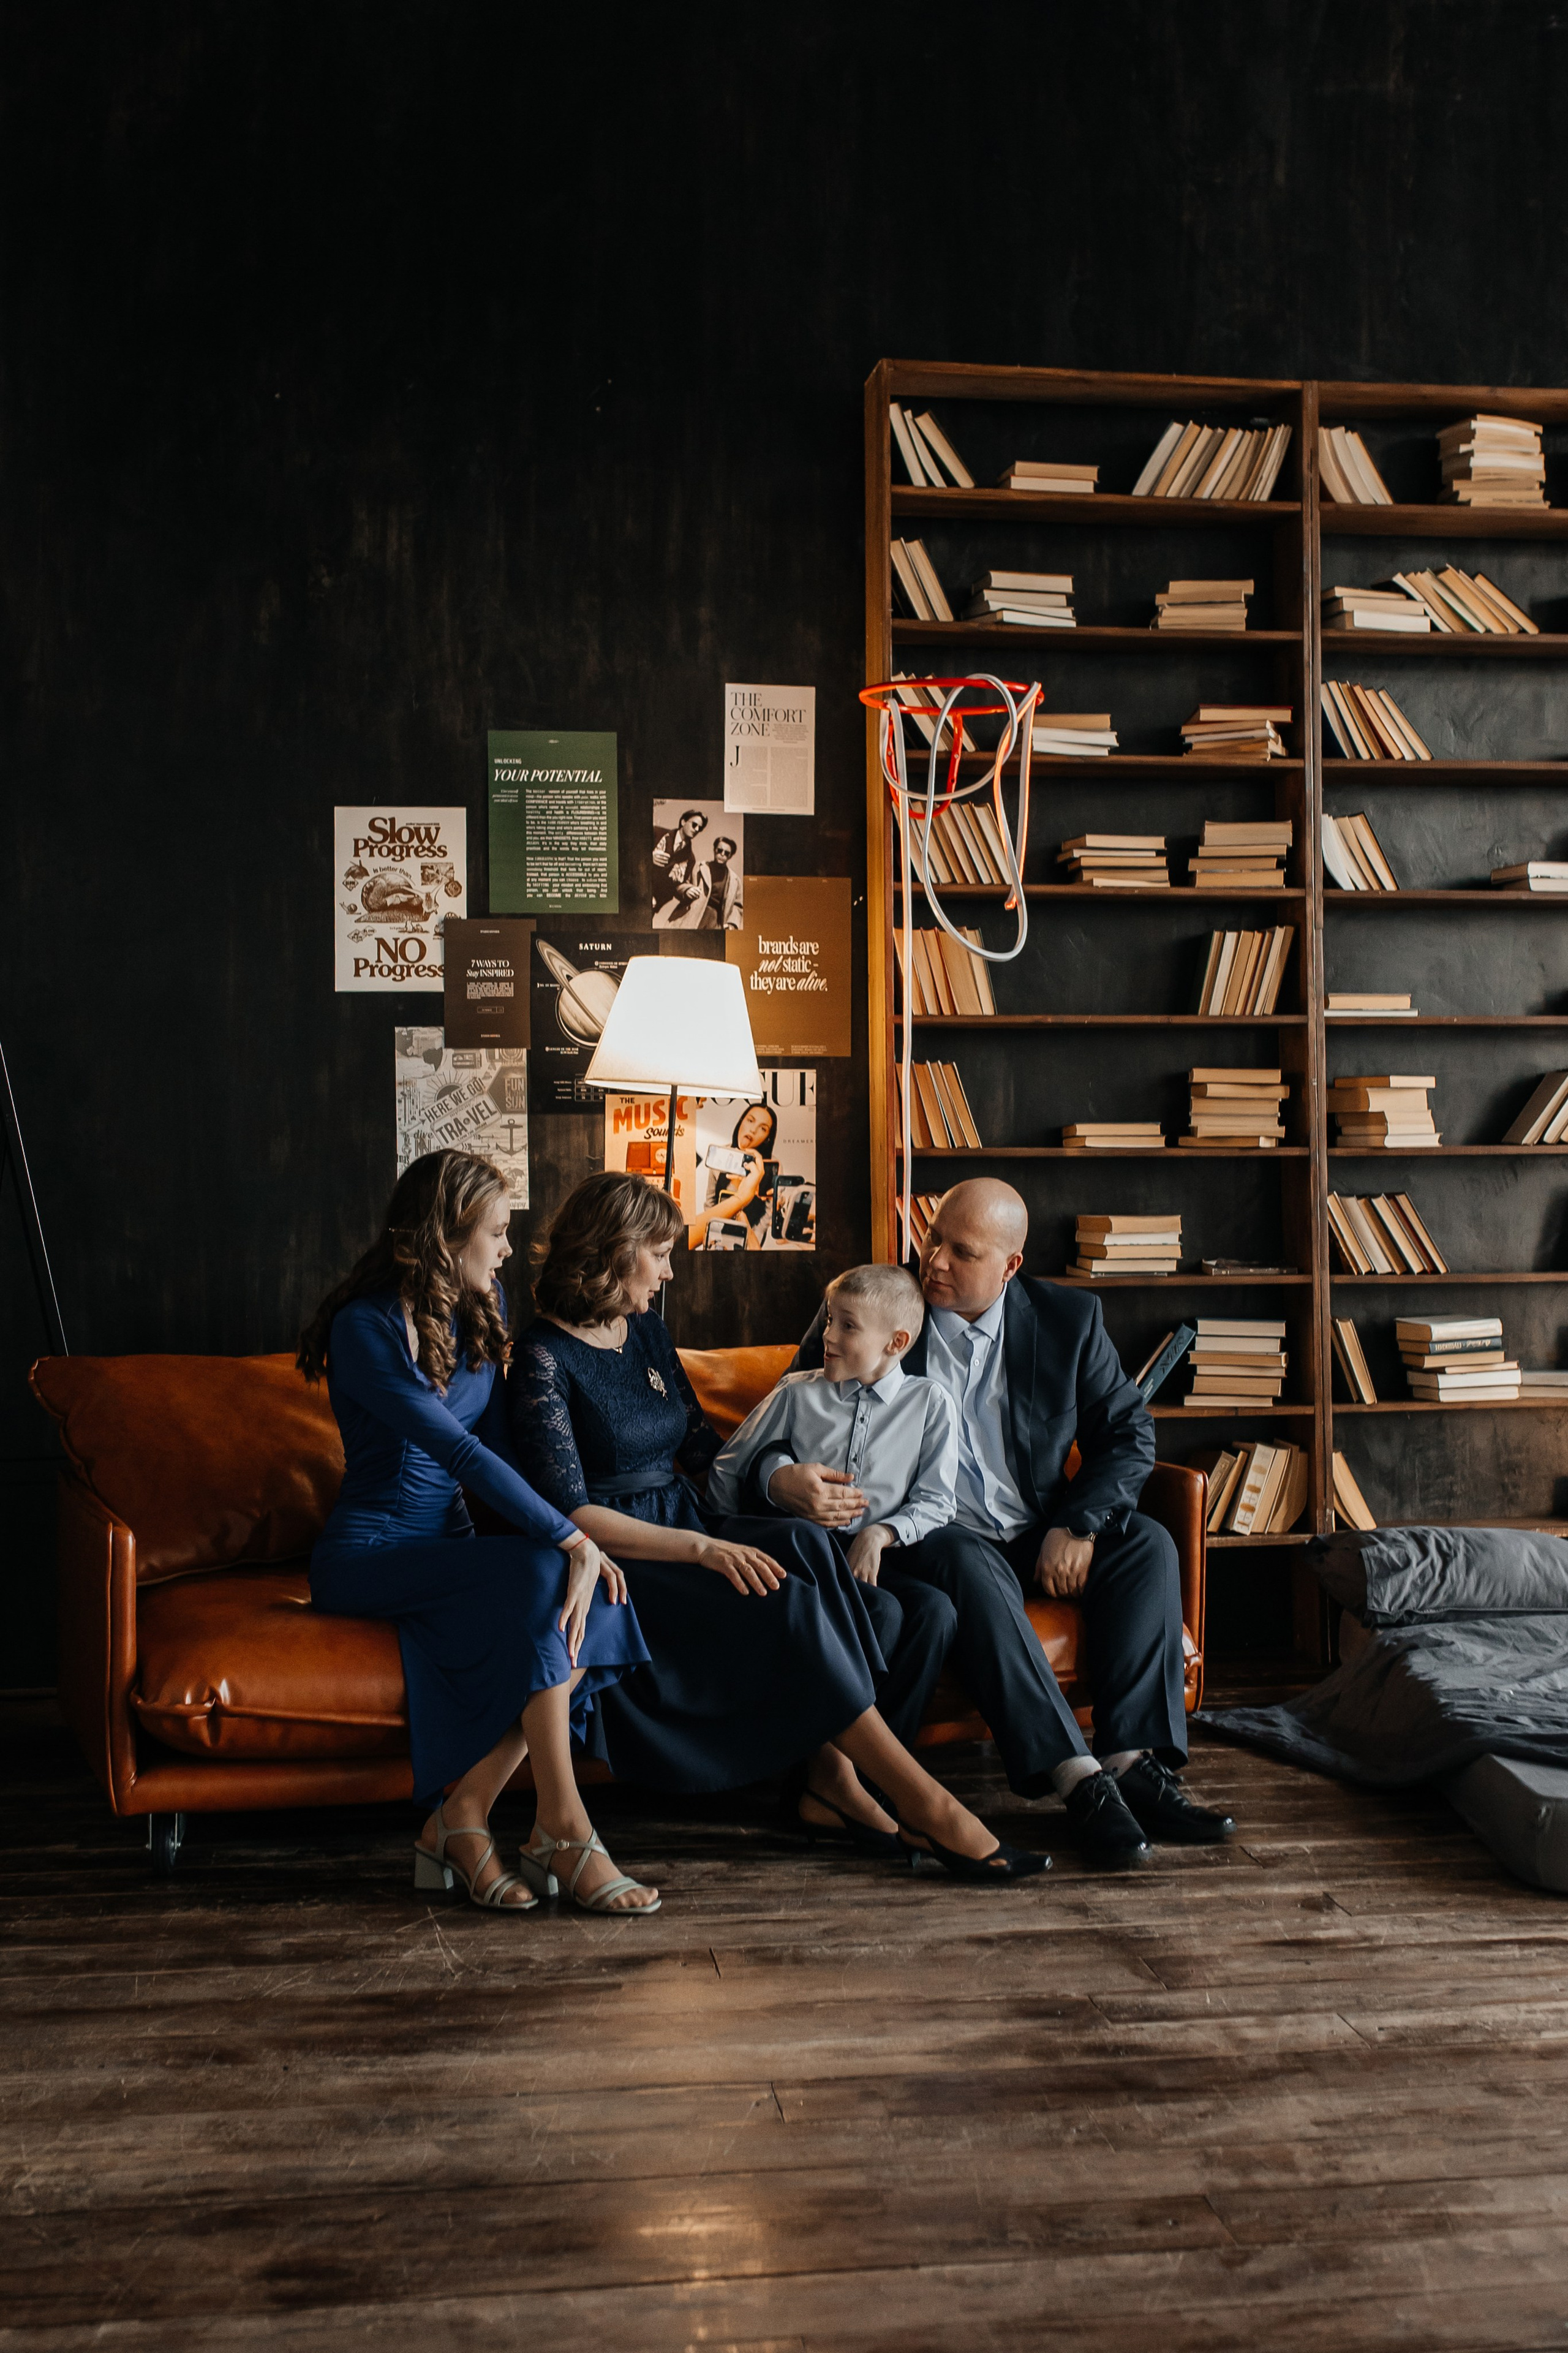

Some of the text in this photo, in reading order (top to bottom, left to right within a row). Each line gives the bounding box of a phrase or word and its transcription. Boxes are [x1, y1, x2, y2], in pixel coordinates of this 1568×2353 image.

[731, 692, 762, 707] THE
[730, 707, 806, 723] COMFORT
[731, 722, 770, 736] ZONE
[494, 769, 603, 783] YOUR POTENTIAL
[368, 817, 440, 845] Slow
[353, 837, 448, 862] Progress
[399, 868, 412, 880] than
[374, 937, 427, 964] NO
[758, 935, 820, 956] brands are
[353, 957, 444, 982] Progress
[471, 959, 510, 968] 7 WAYS TO
[758, 955, 783, 973] not
[782, 955, 812, 973] static
[466, 969, 514, 979] Stay INSPIRED
[750, 970, 828, 995] they are alive.
[505, 1078, 525, 1092] FUN
[423, 1100, 453, 1123] HERE
[449, 1086, 469, 1106] WE
[505, 1095, 526, 1111] SUN
[613, 1096, 688, 1134] MUSC
